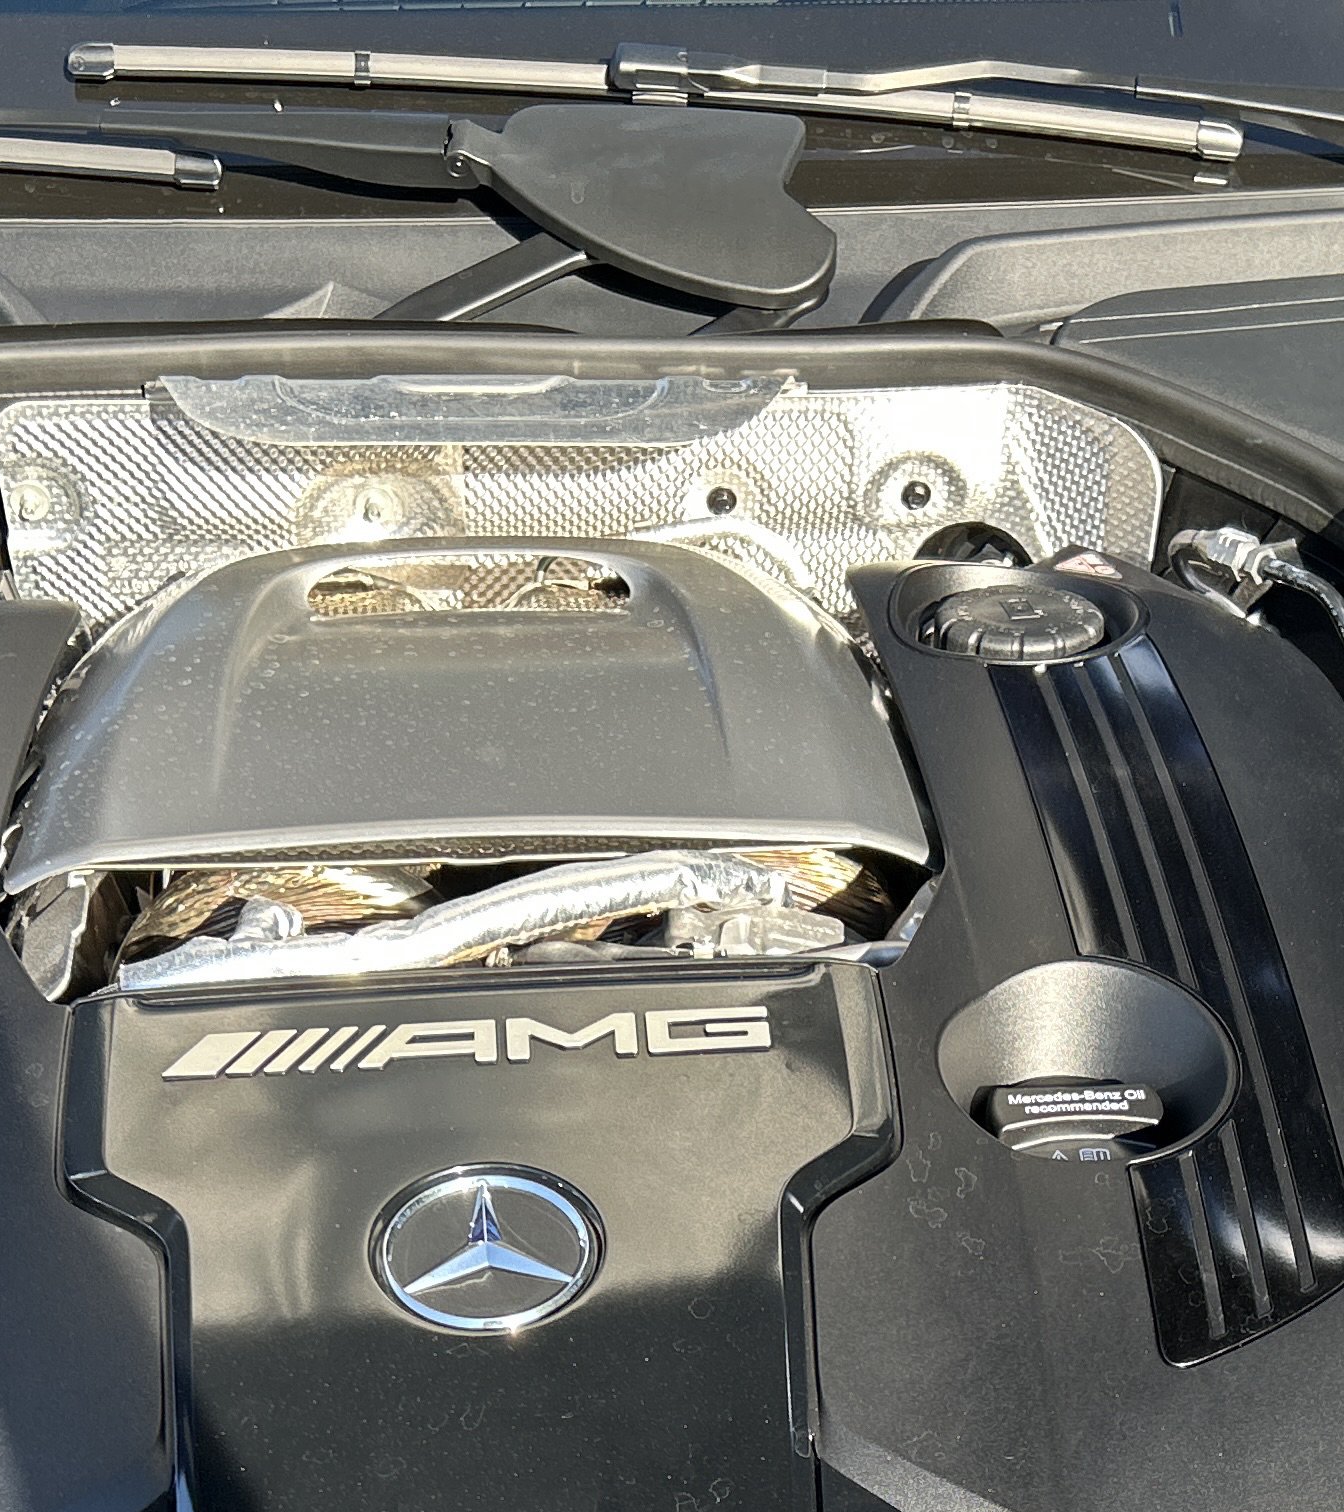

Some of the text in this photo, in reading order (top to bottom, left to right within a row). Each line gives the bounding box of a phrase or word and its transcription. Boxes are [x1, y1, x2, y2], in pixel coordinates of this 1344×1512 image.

[357, 1005, 773, 1072] AMG
[1007, 1088, 1147, 1105] Mercedes-Benz Oil
[1024, 1099, 1129, 1114] recommended
